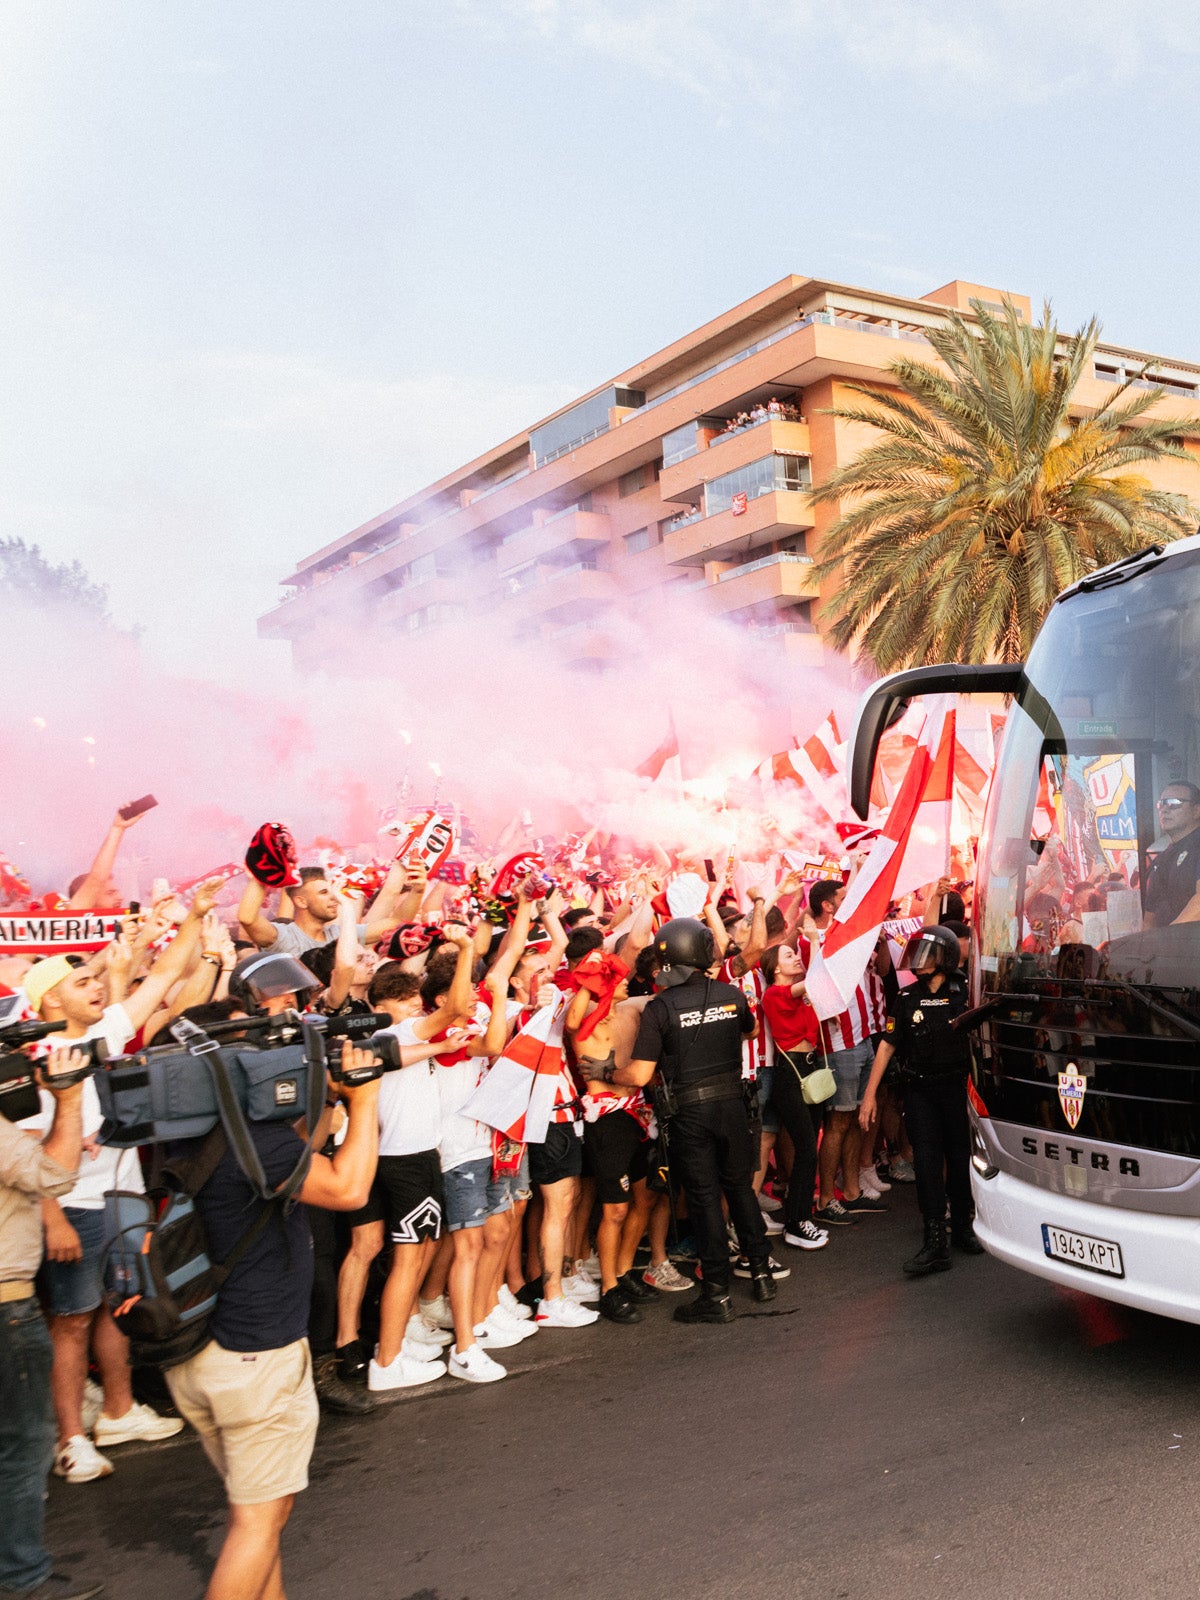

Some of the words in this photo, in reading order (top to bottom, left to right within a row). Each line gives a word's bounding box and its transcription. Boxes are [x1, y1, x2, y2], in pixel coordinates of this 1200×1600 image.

[1083, 724, 1114, 733] Entrada
[680, 1006, 726, 1021] POLCIA
[347, 1017, 376, 1028] RØDE
[1022, 1137, 1140, 1177] SETRA
[1053, 1232, 1085, 1259] 1943
[1088, 1242, 1115, 1268] KPT
